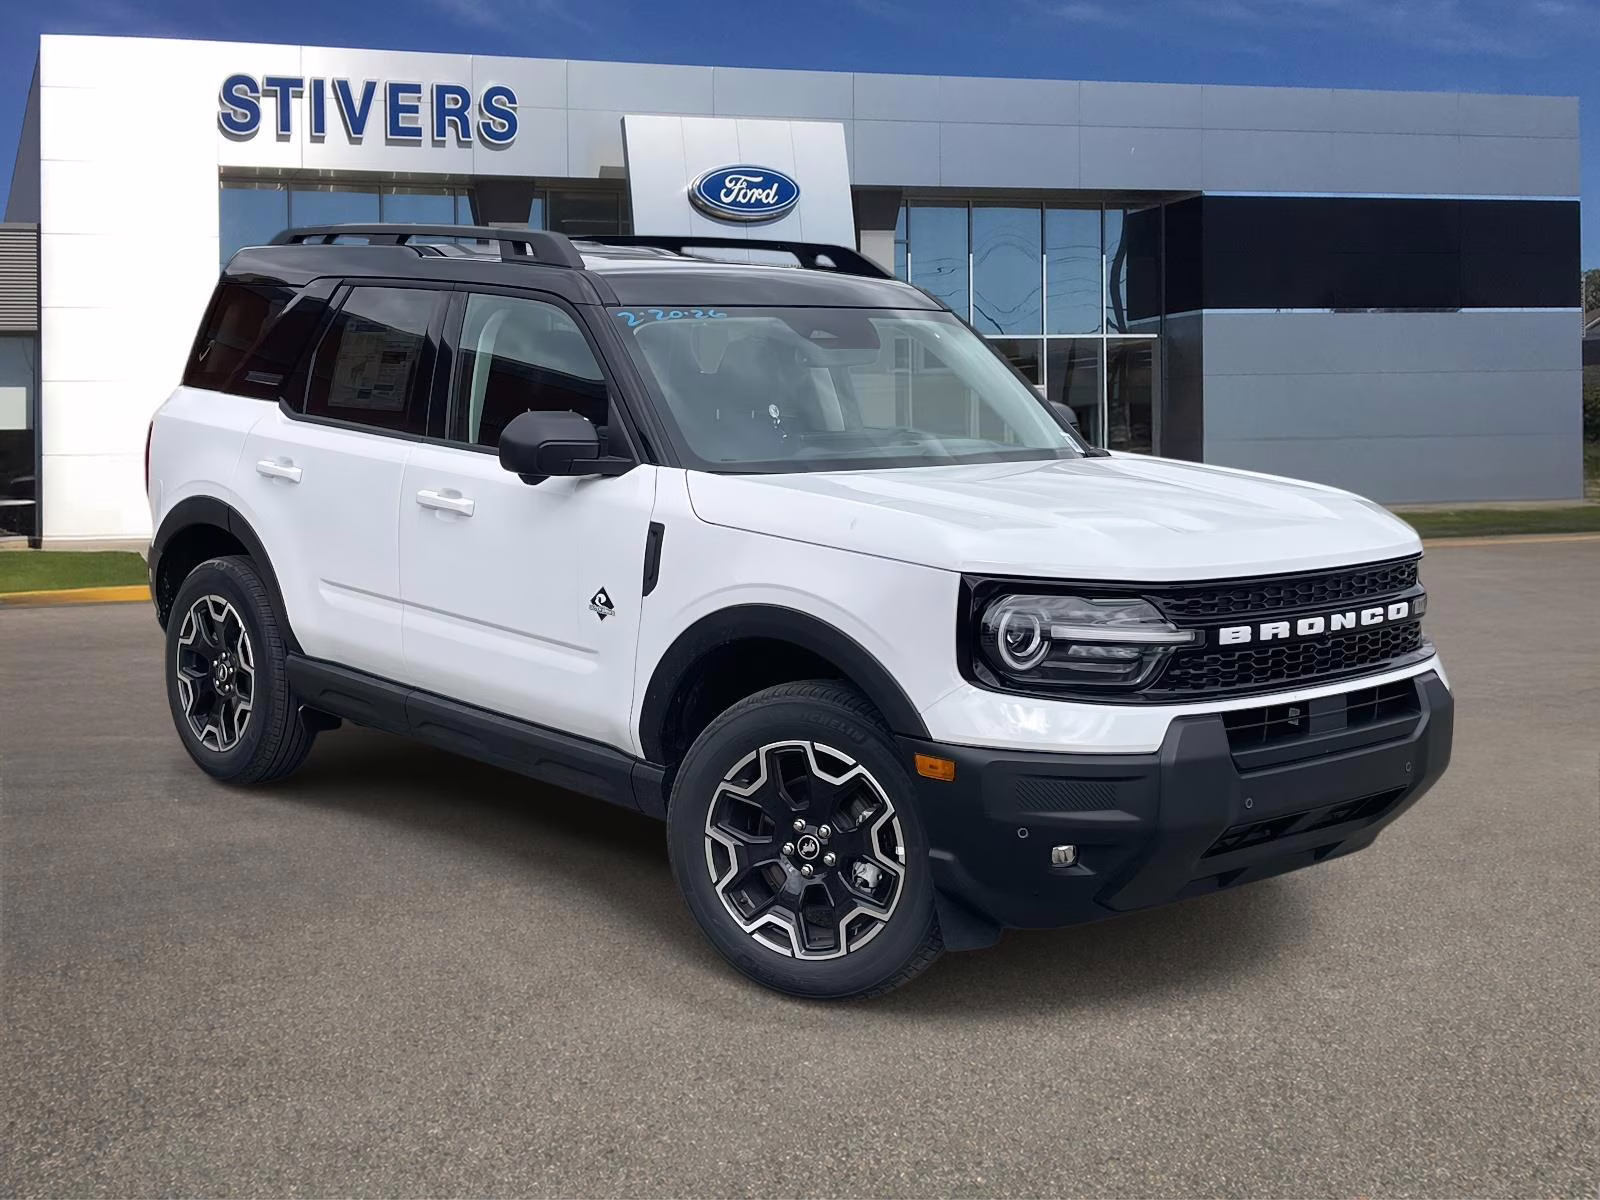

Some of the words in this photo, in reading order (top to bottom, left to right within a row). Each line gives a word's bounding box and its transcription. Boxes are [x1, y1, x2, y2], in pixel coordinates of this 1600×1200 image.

[218, 74, 518, 147] STIVERS
[720, 174, 779, 204] Ford
[1219, 602, 1409, 645] BRONCO
[799, 710, 866, 743] ICHELIN
